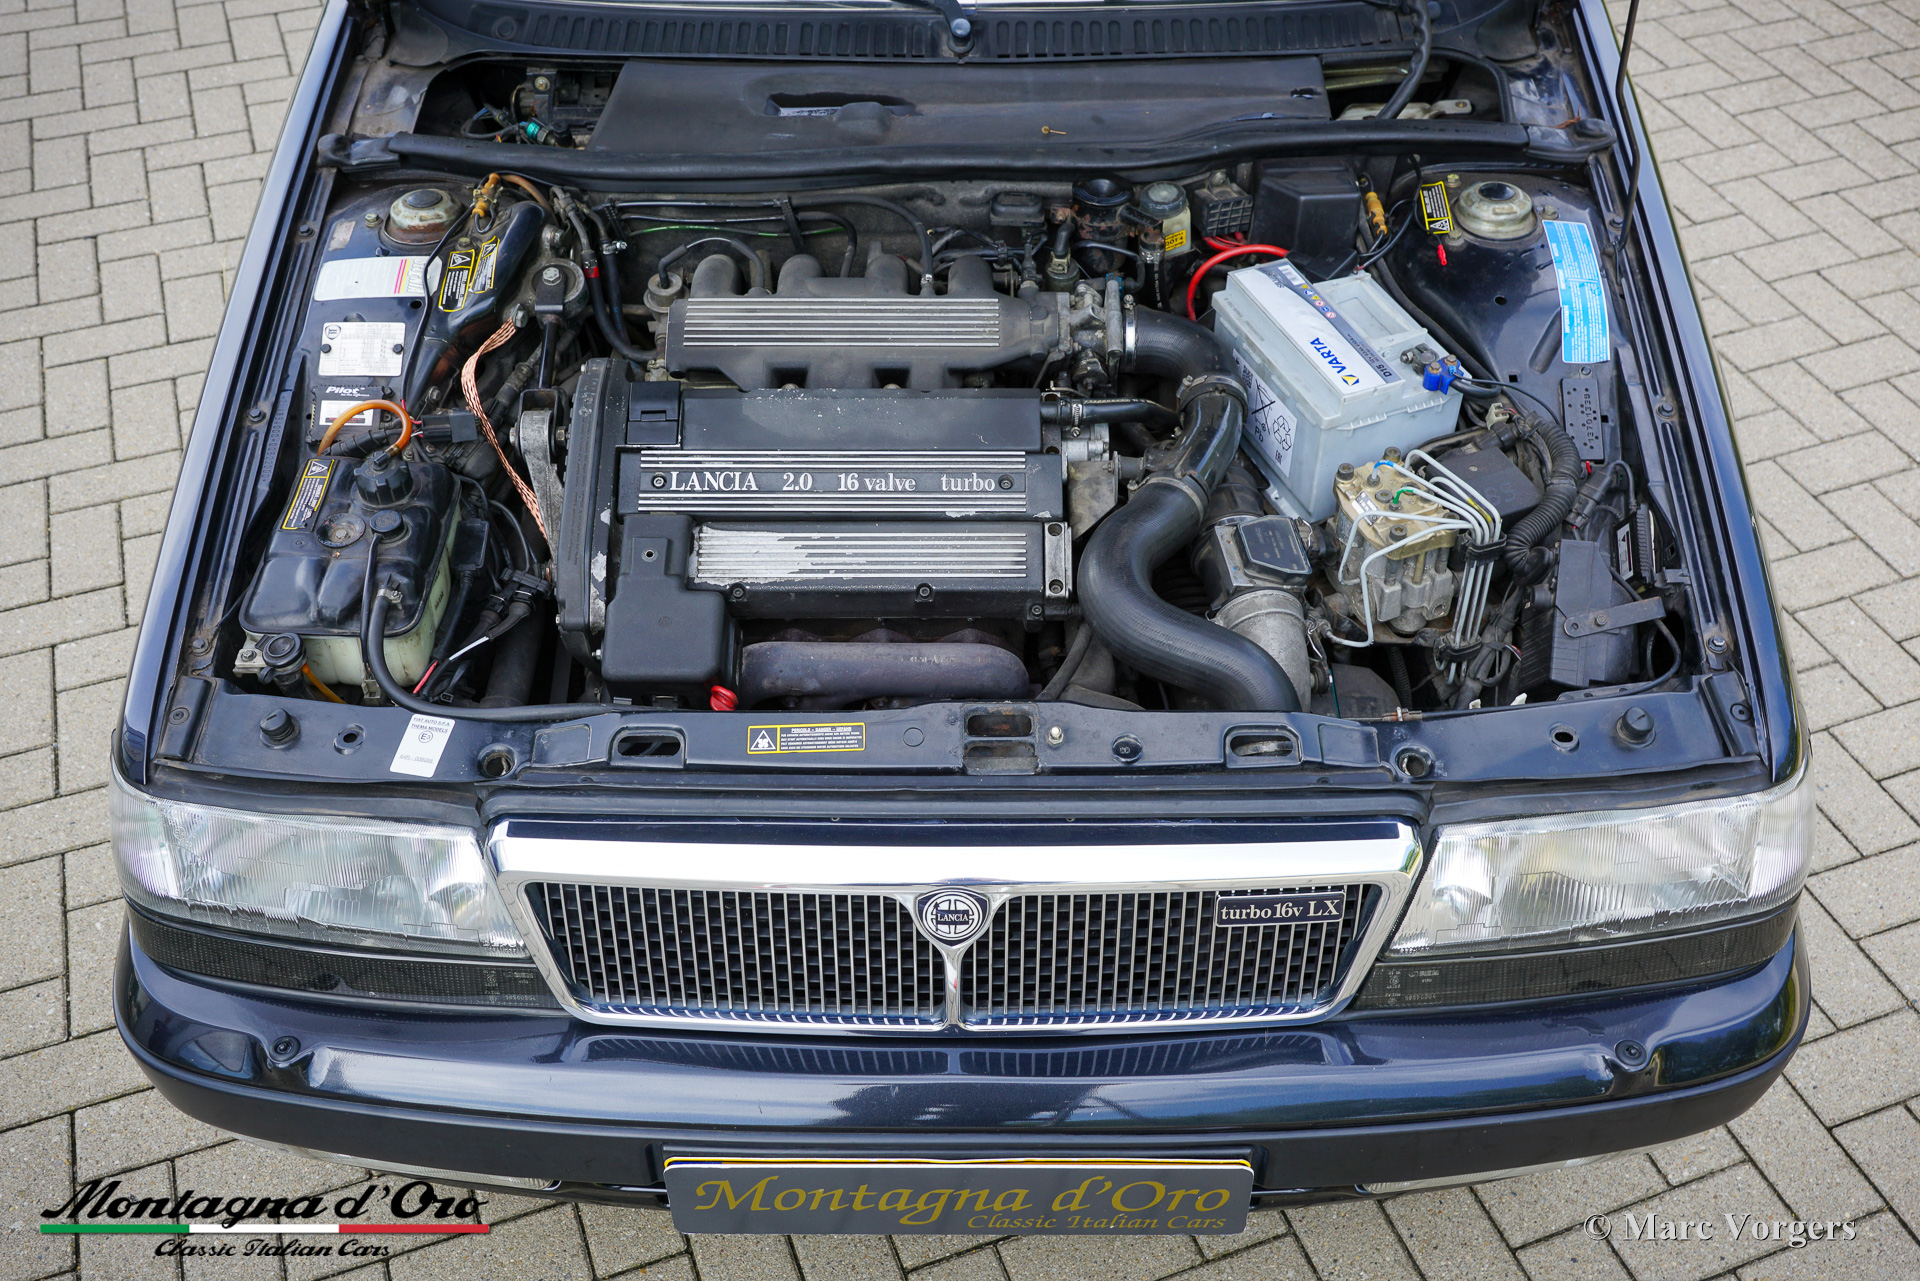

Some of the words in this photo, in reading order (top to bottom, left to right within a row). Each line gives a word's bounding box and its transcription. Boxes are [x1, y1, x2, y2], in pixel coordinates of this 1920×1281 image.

[1310, 337, 1347, 374] VARTA
[1376, 364, 1392, 378] D15
[326, 386, 360, 394] Pilot
[1254, 426, 1264, 443] Pb
[670, 471, 759, 491] LANCIA
[782, 472, 813, 491] 2.0
[838, 472, 860, 491] 16
[864, 473, 917, 491] valve
[941, 472, 996, 491] turbo
[937, 913, 969, 922] LANCIA
[1221, 905, 1272, 920] turbo
[1273, 902, 1304, 918] 16v
[1307, 900, 1340, 917] LX
[695, 1175, 1033, 1225] Montagna
[967, 1214, 1057, 1230] Classic
[1067, 1214, 1157, 1230] Italian
[1161, 1214, 1226, 1230] Cars
